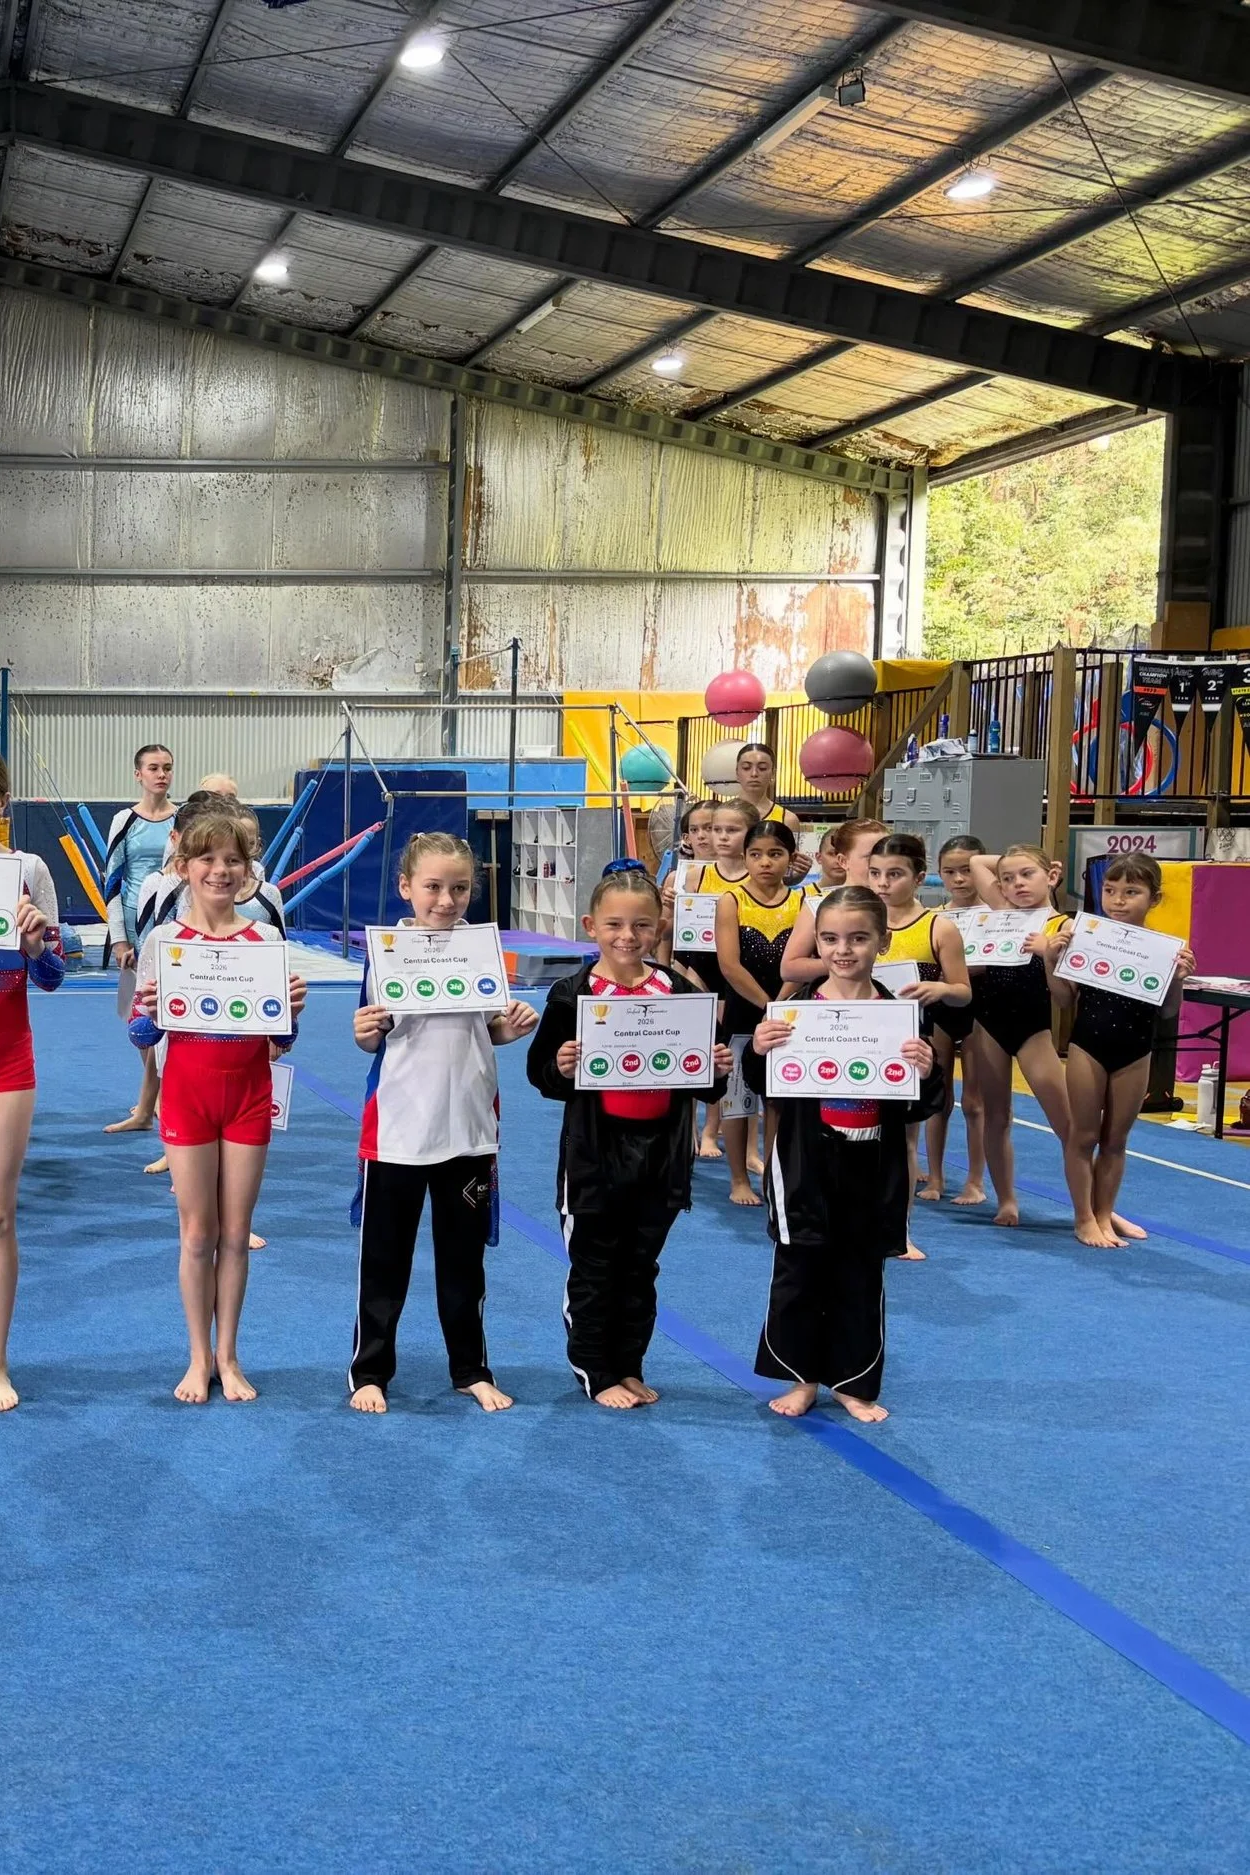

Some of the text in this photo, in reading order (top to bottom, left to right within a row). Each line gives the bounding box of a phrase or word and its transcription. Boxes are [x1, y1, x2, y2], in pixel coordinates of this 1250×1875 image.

[1107, 834, 1157, 854] 2024
[1096, 940, 1150, 960] Central Coast Cup
[403, 957, 431, 965] Central
[452, 956, 469, 964] Cup
[189, 973, 254, 983] Central Coast Cup
[613, 1029, 642, 1037] Central
[665, 1028, 681, 1037] Cup
[804, 1035, 879, 1044] Central Coast Cup
